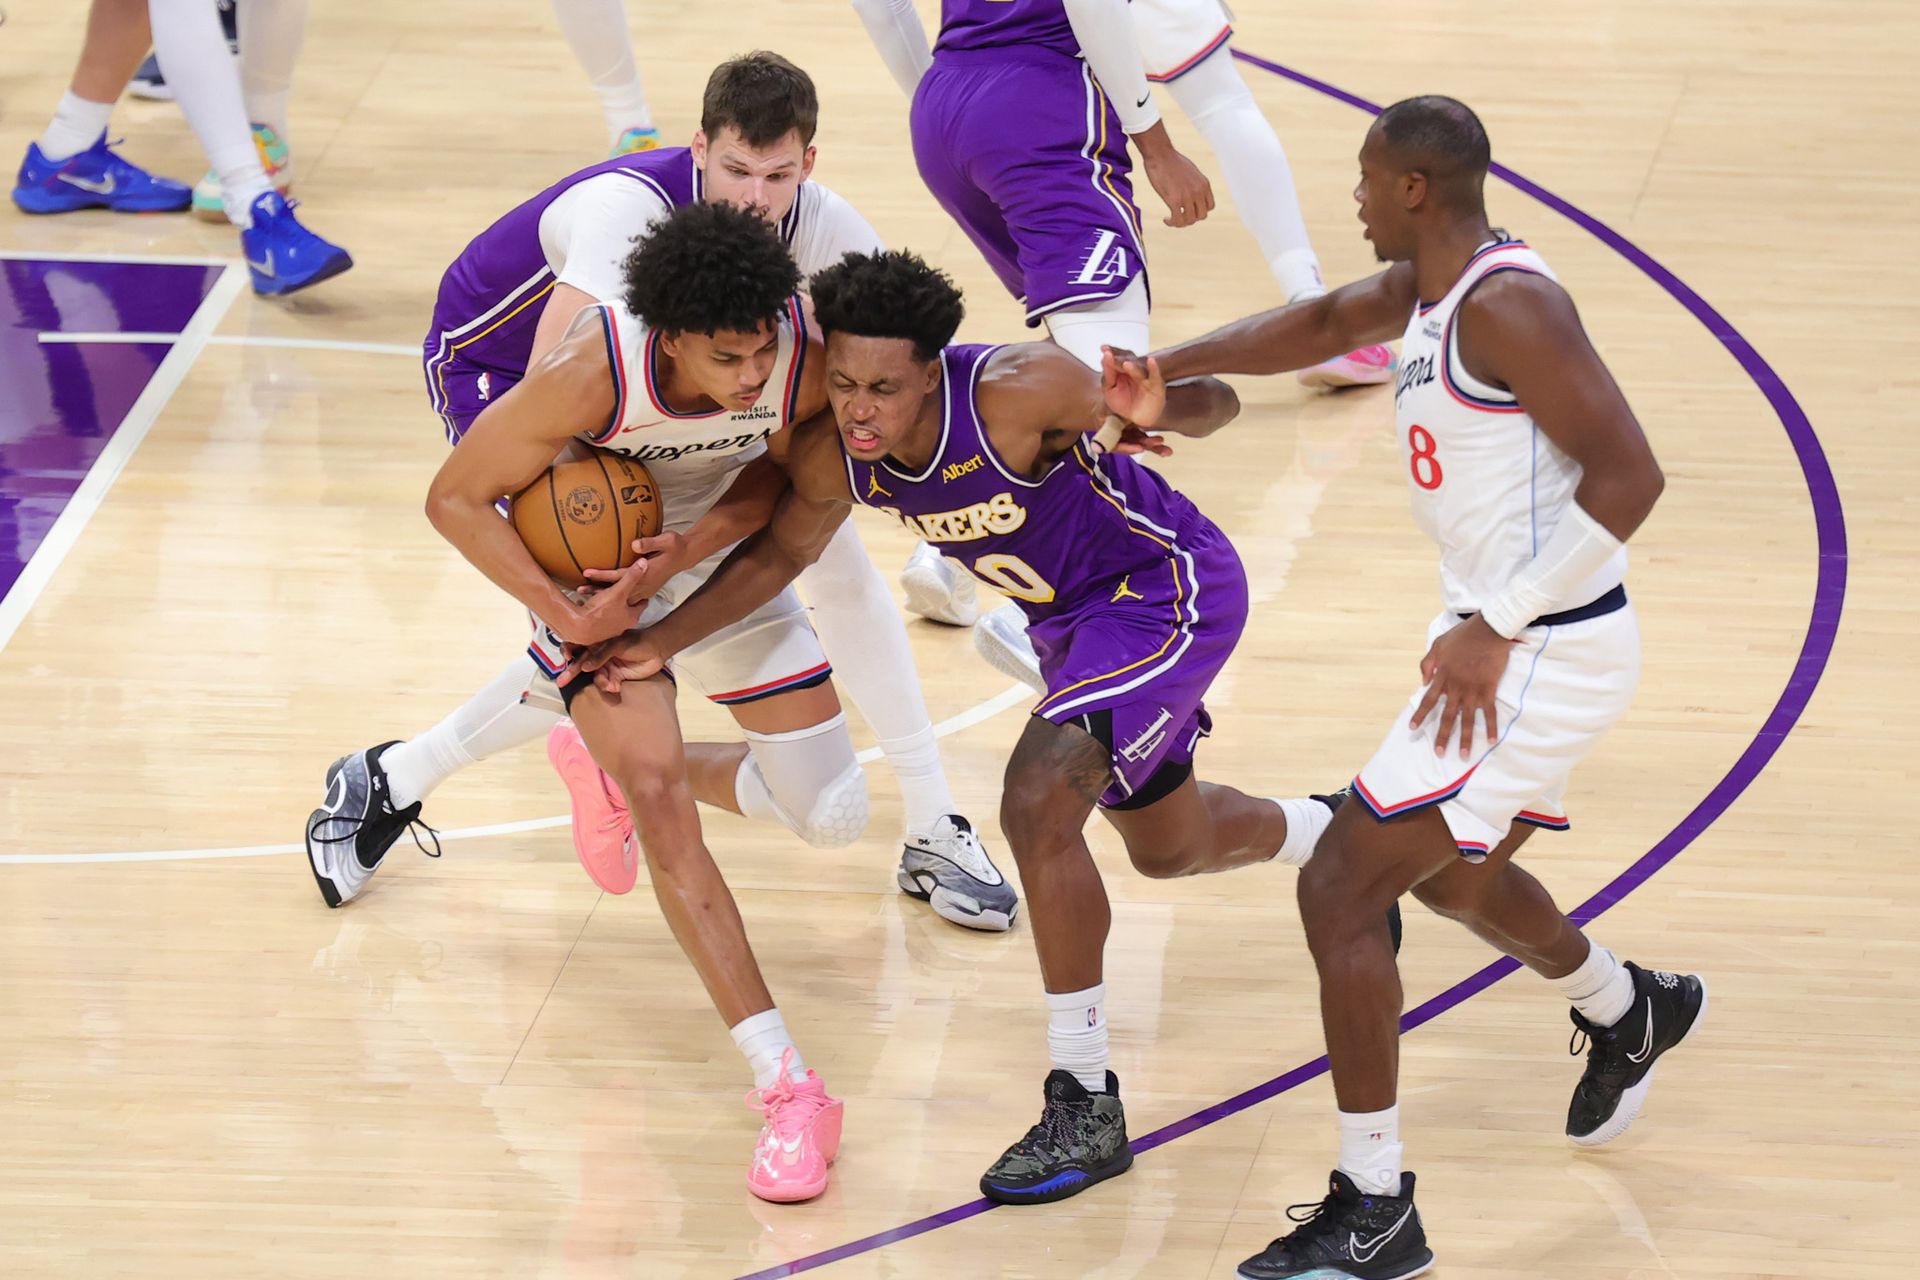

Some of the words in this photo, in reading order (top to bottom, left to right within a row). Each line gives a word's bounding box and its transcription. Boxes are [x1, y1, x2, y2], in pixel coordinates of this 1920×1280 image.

[730, 411, 777, 421] RWANDA
[942, 454, 985, 484] Albert
[1408, 424, 1443, 491] 8
[881, 492, 1026, 543] AKERS
[945, 553, 1056, 603] 0
